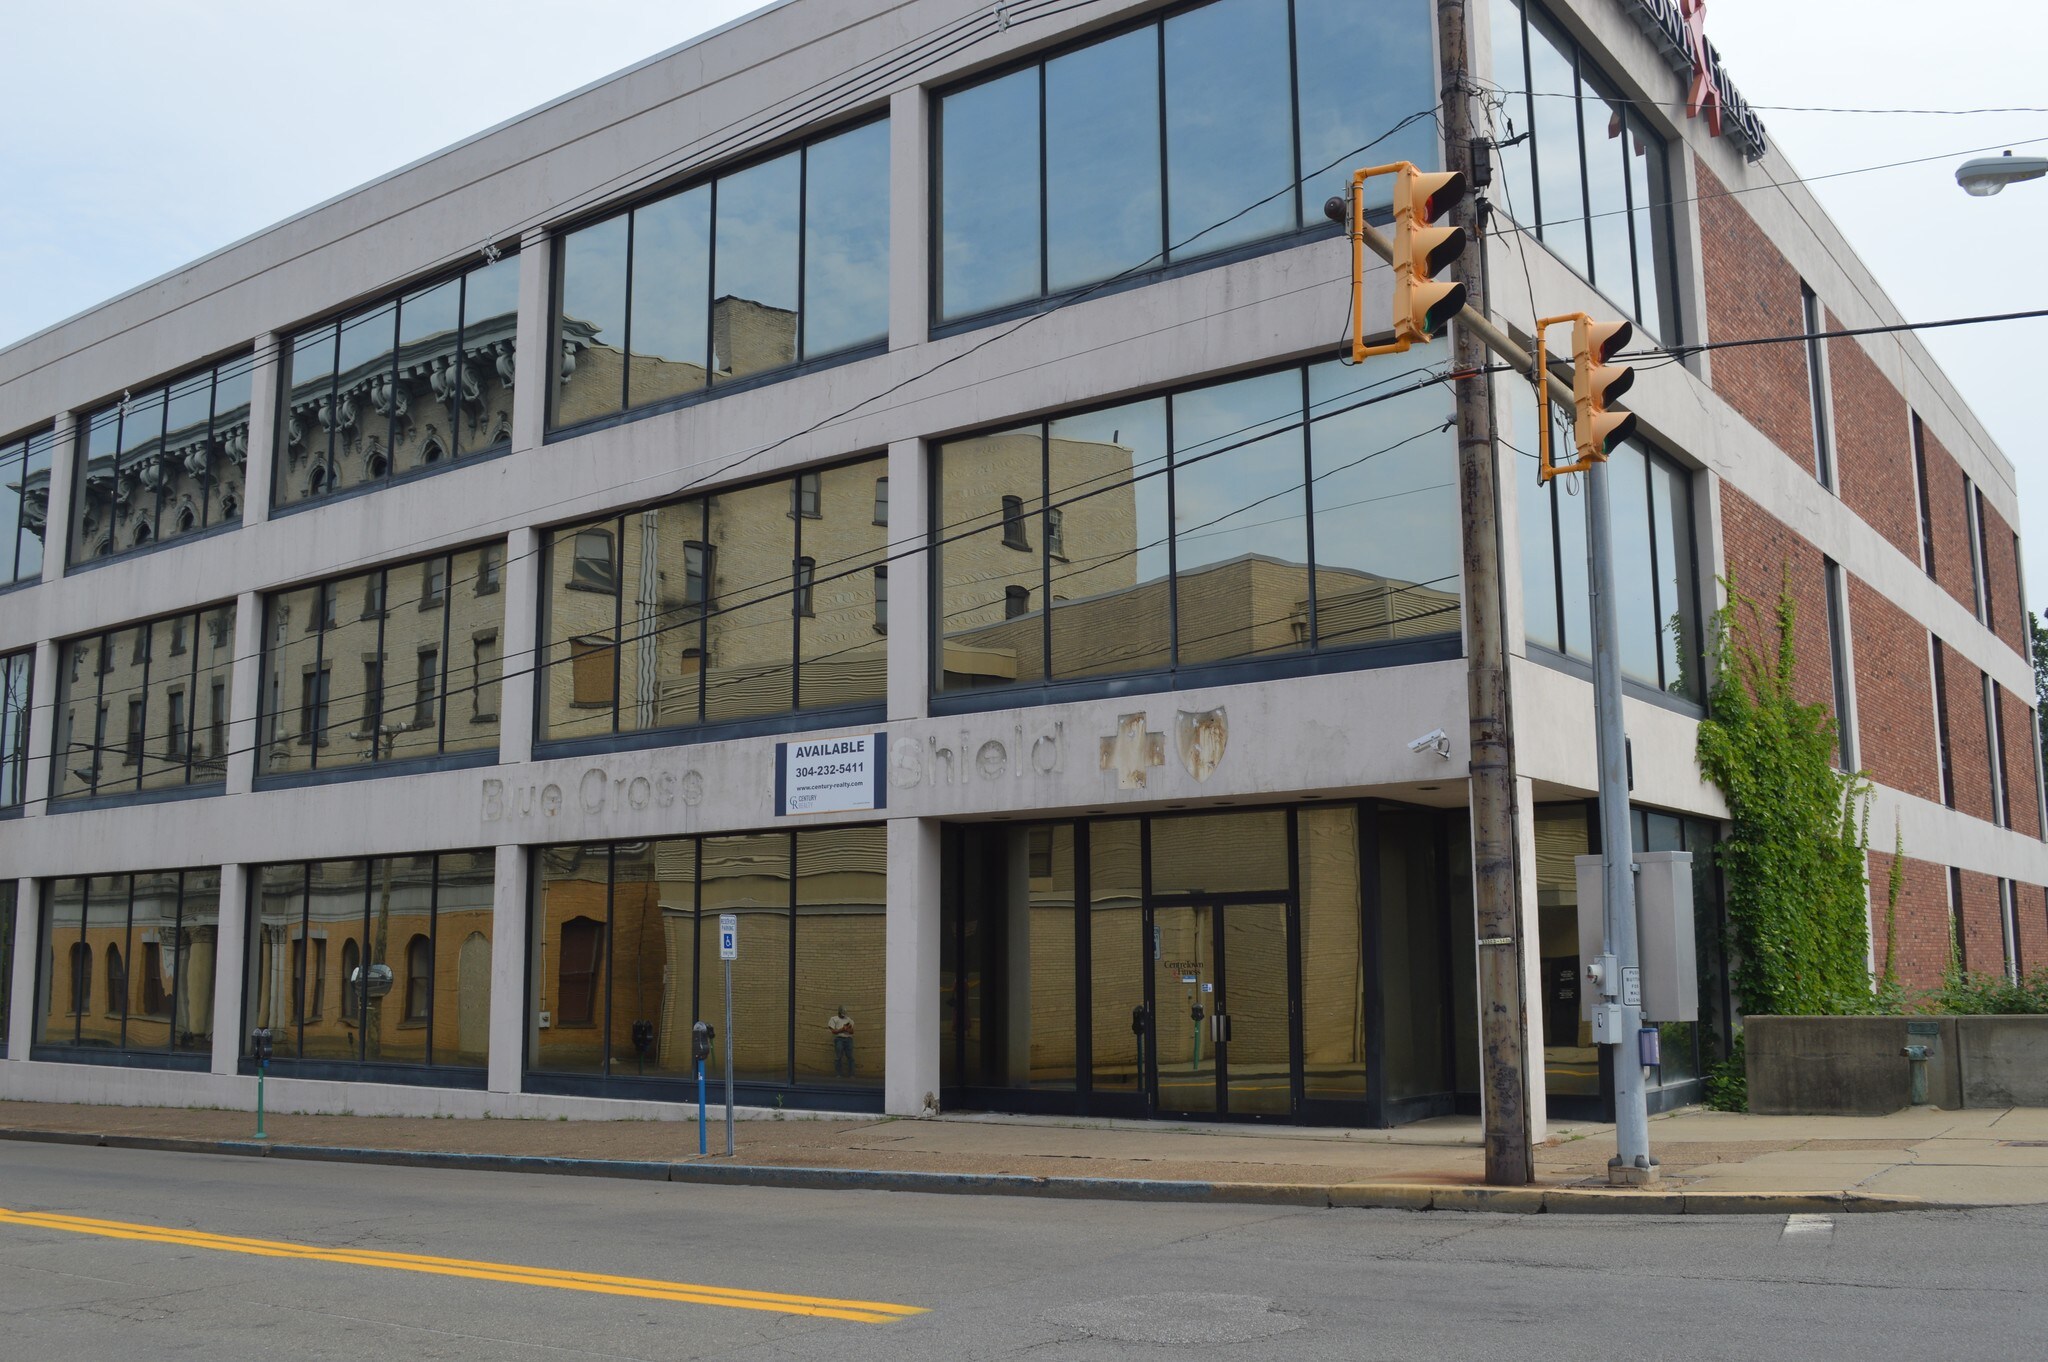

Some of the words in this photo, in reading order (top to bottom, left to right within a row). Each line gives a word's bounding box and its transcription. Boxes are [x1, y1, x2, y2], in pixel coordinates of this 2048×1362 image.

[1703, 34, 1768, 156] Fitness
[796, 740, 865, 758] AVAILABLE
[482, 778, 562, 822] Blue
[579, 768, 704, 815] Cross
[888, 721, 1064, 789] Shield
[796, 762, 864, 778] 304-232-5411
[796, 781, 864, 791] www.century-realty.com
